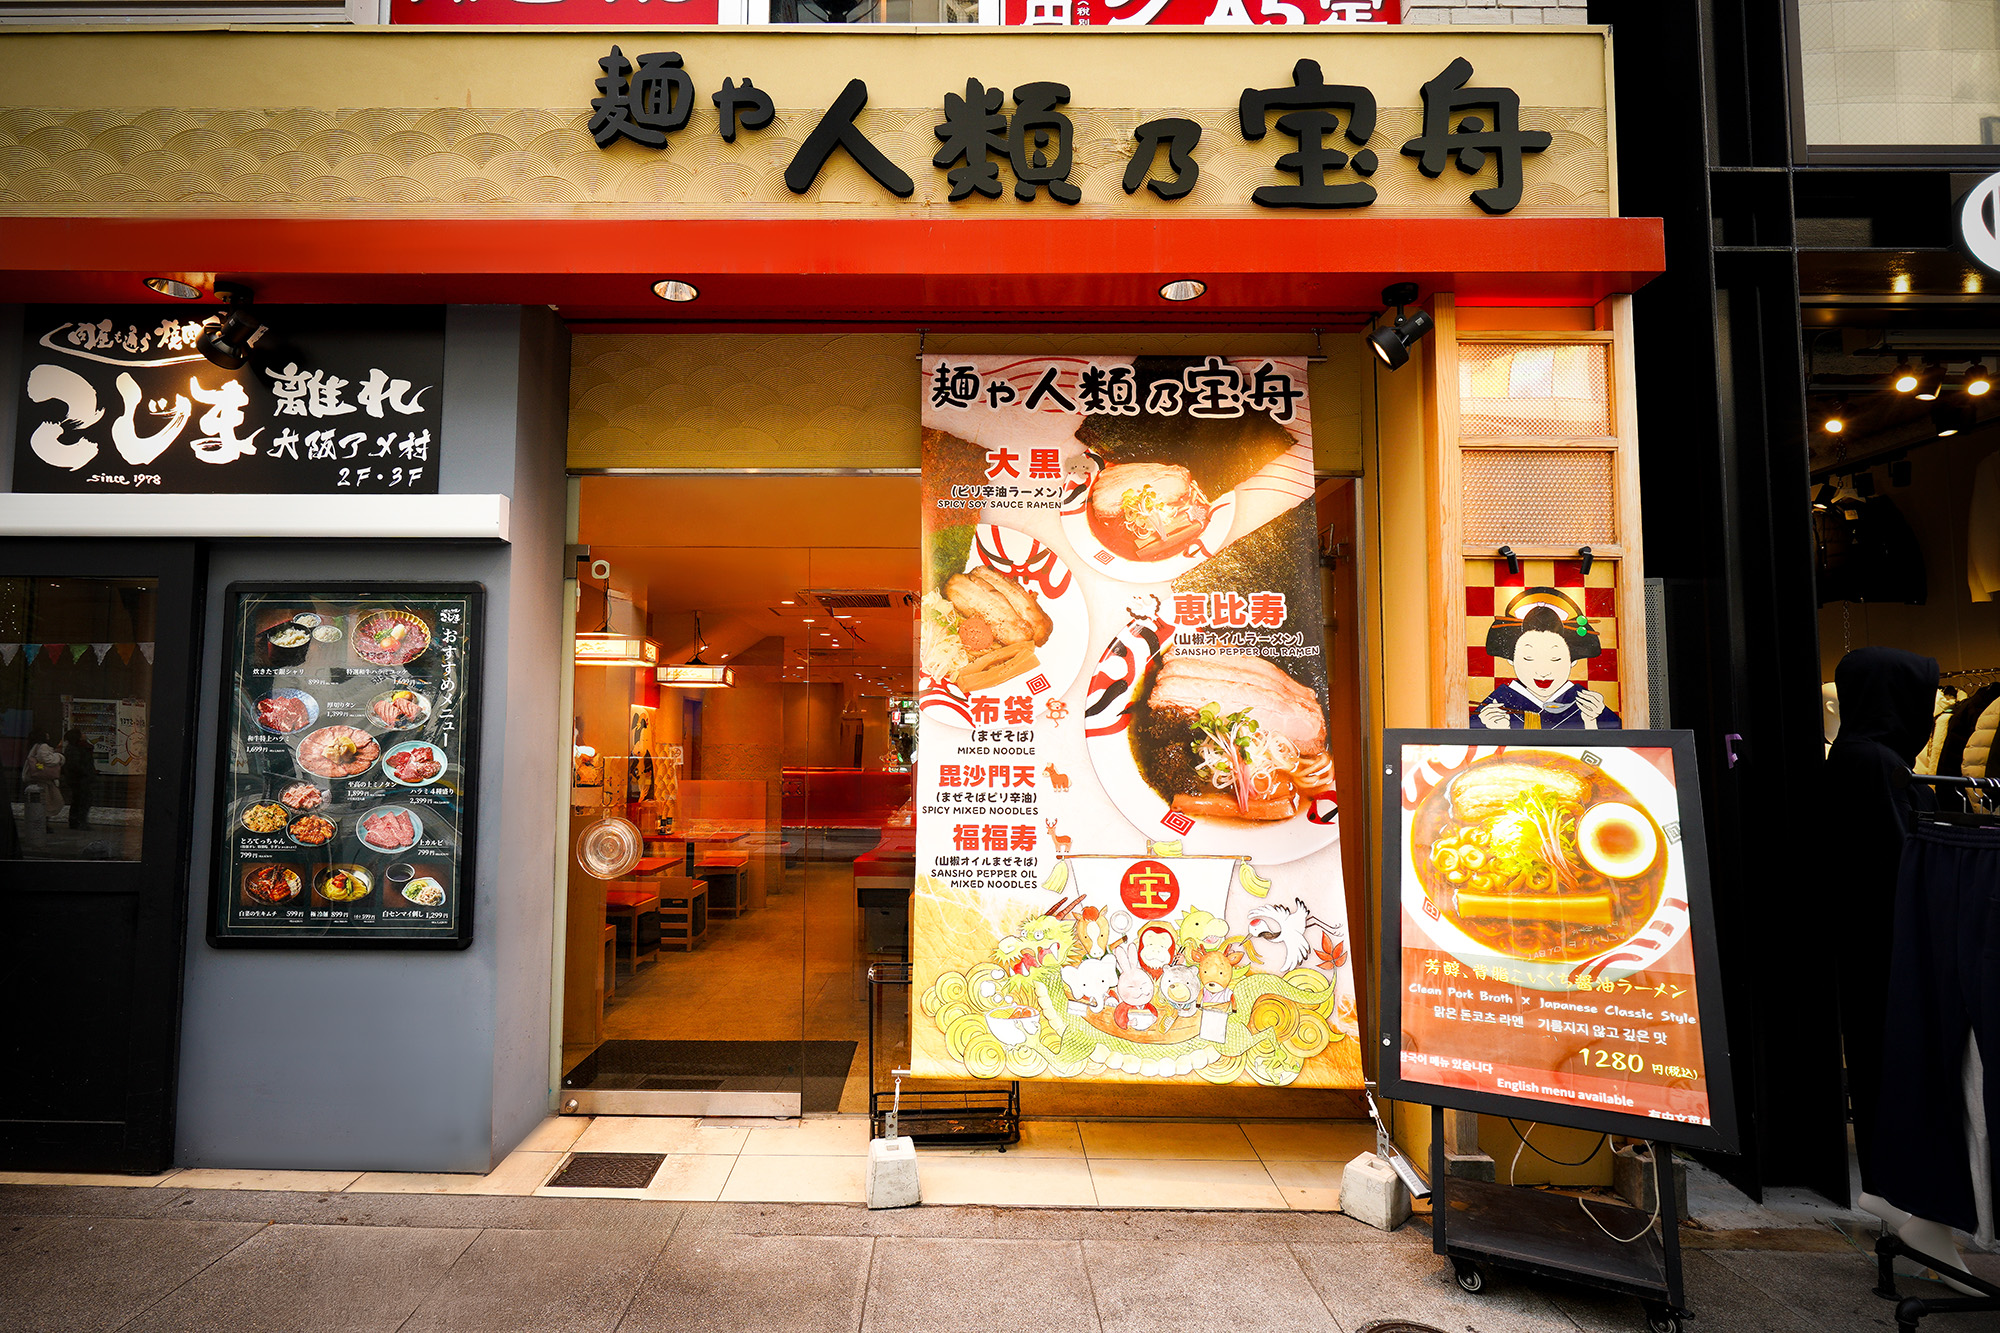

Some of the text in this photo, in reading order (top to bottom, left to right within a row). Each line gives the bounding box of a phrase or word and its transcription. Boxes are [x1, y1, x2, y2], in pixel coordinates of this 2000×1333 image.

[265, 362, 433, 418] 離れ
[27, 364, 265, 472] こじま
[267, 428, 430, 461] 大阪アメ村
[987, 447, 1061, 479] 大黒
[87, 473, 161, 486] since 1978
[952, 485, 1063, 498] (ピリ辛油ラーメン)
[938, 500, 1062, 509] SPICY SOY SAUCE RAMEN
[1173, 593, 1285, 626] 恵比寿
[1174, 632, 1304, 646] (山椒オイルラーメン)
[1175, 646, 1320, 657] SANSHO PEPPER OIL RAMEN
[439, 628, 458, 747] おすすめメニュー
[970, 695, 1034, 725] 布袋
[971, 730, 1034, 742] (まぜそば)
[957, 747, 1036, 755] MIXED NOODLE
[938, 764, 1036, 788] 毘沙門天
[936, 792, 1037, 804] (まぜそばピリ辛油)
[922, 806, 1039, 815] SPICY MIXED NOODLES
[952, 824, 1037, 851] 福福寿
[930, 869, 1037, 878] SANSHO PEPPER OIL
[950, 880, 1038, 889] MIXED NOODLES
[1408, 983, 1442, 996] Clean
[1447, 987, 1474, 1000] Pork
[1479, 991, 1513, 1004] Broth
[1539, 997, 1598, 1014] Japanese
[1604, 1005, 1654, 1020] Classic
[1660, 1011, 1697, 1025] Style
[1433, 1006, 1668, 1046] 맑은 돈코츠 라멘 기름지지 않고 깊은 맛
[1429, 1055, 1450, 1068] 메뉴
[1451, 1058, 1494, 1075] 있습니다
[1578, 1047, 1644, 1073] 1280
[1497, 1078, 1634, 1108] English menu available
